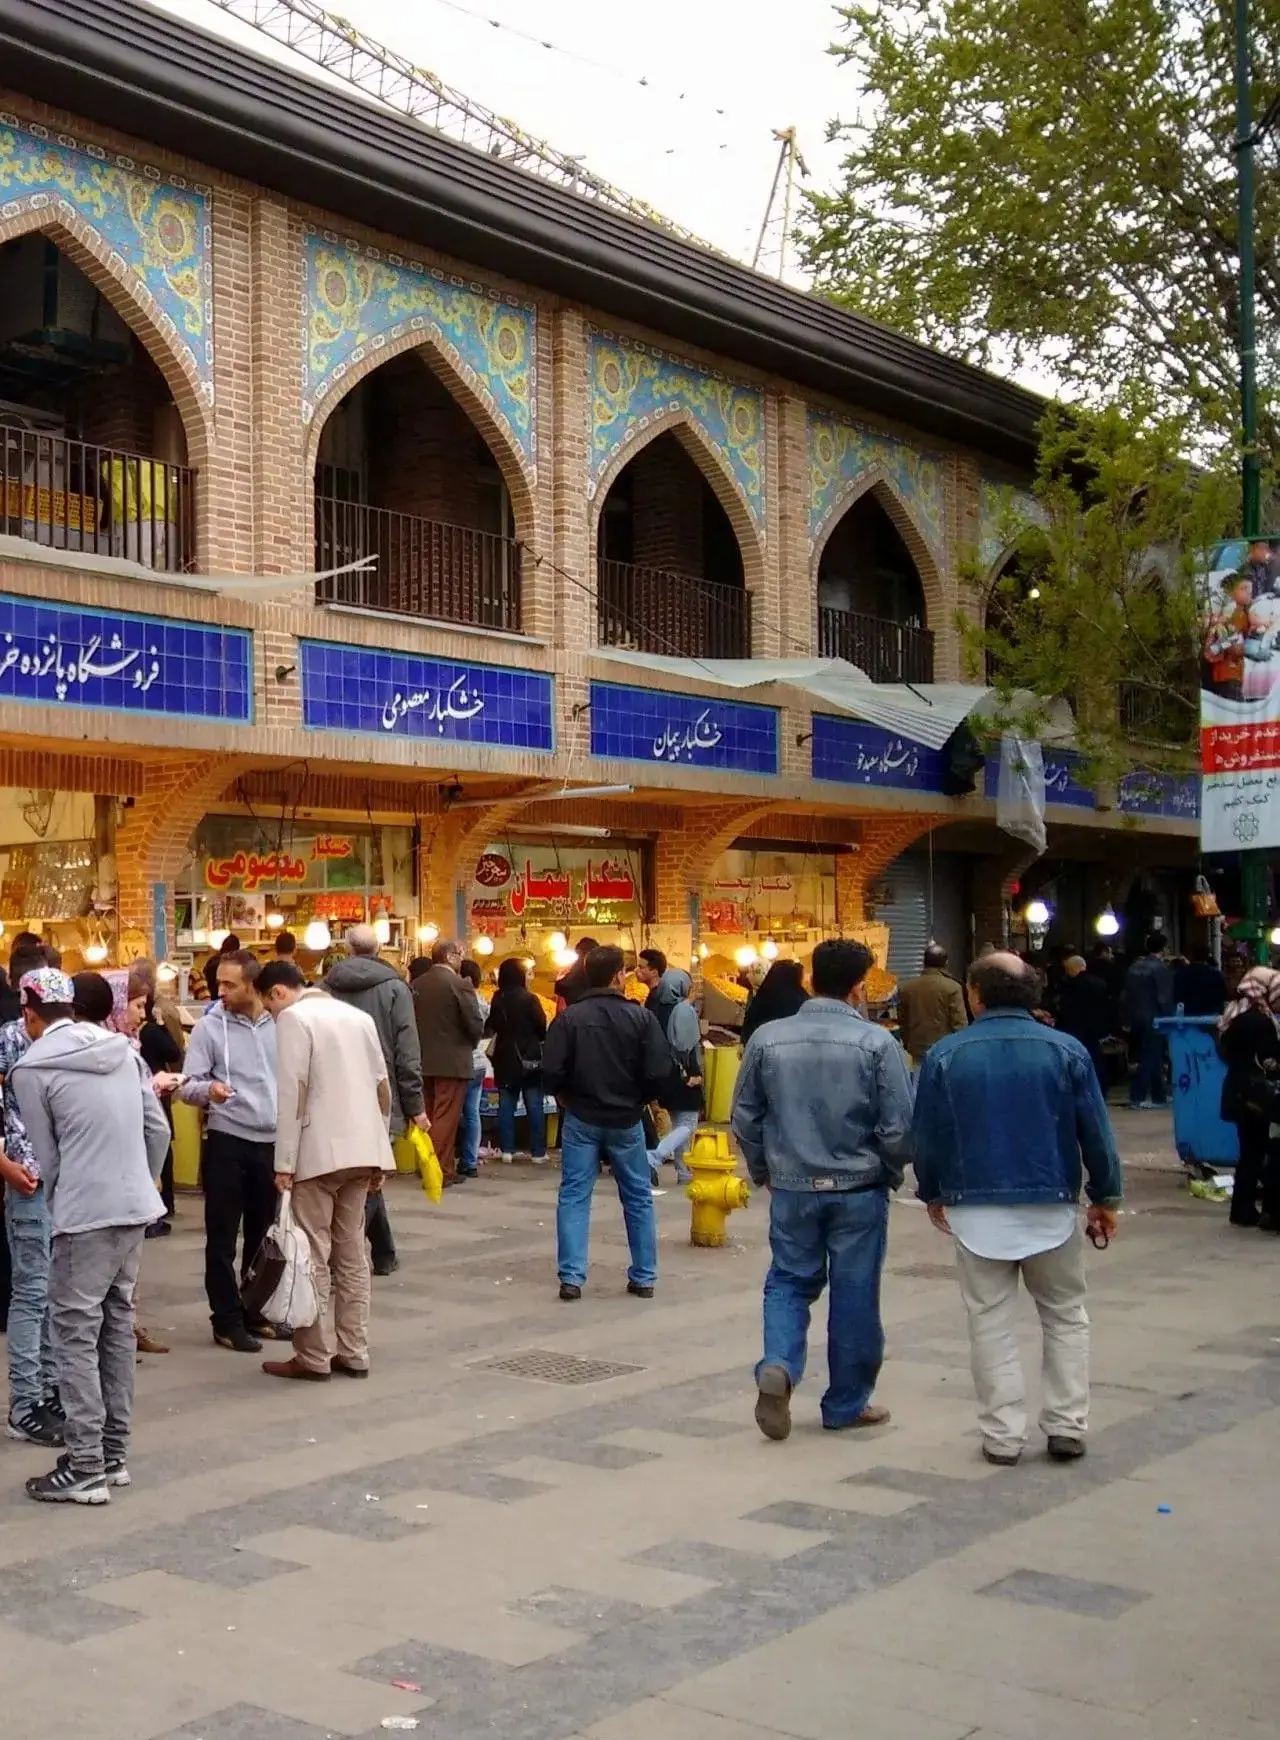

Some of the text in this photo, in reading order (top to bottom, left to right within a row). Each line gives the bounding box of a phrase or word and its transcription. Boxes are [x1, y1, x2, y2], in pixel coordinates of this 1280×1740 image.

[20, 633, 67, 700] پانزده
[68, 633, 160, 691] فروشگاه
[382, 674, 485, 733] خشکبار معصومی
